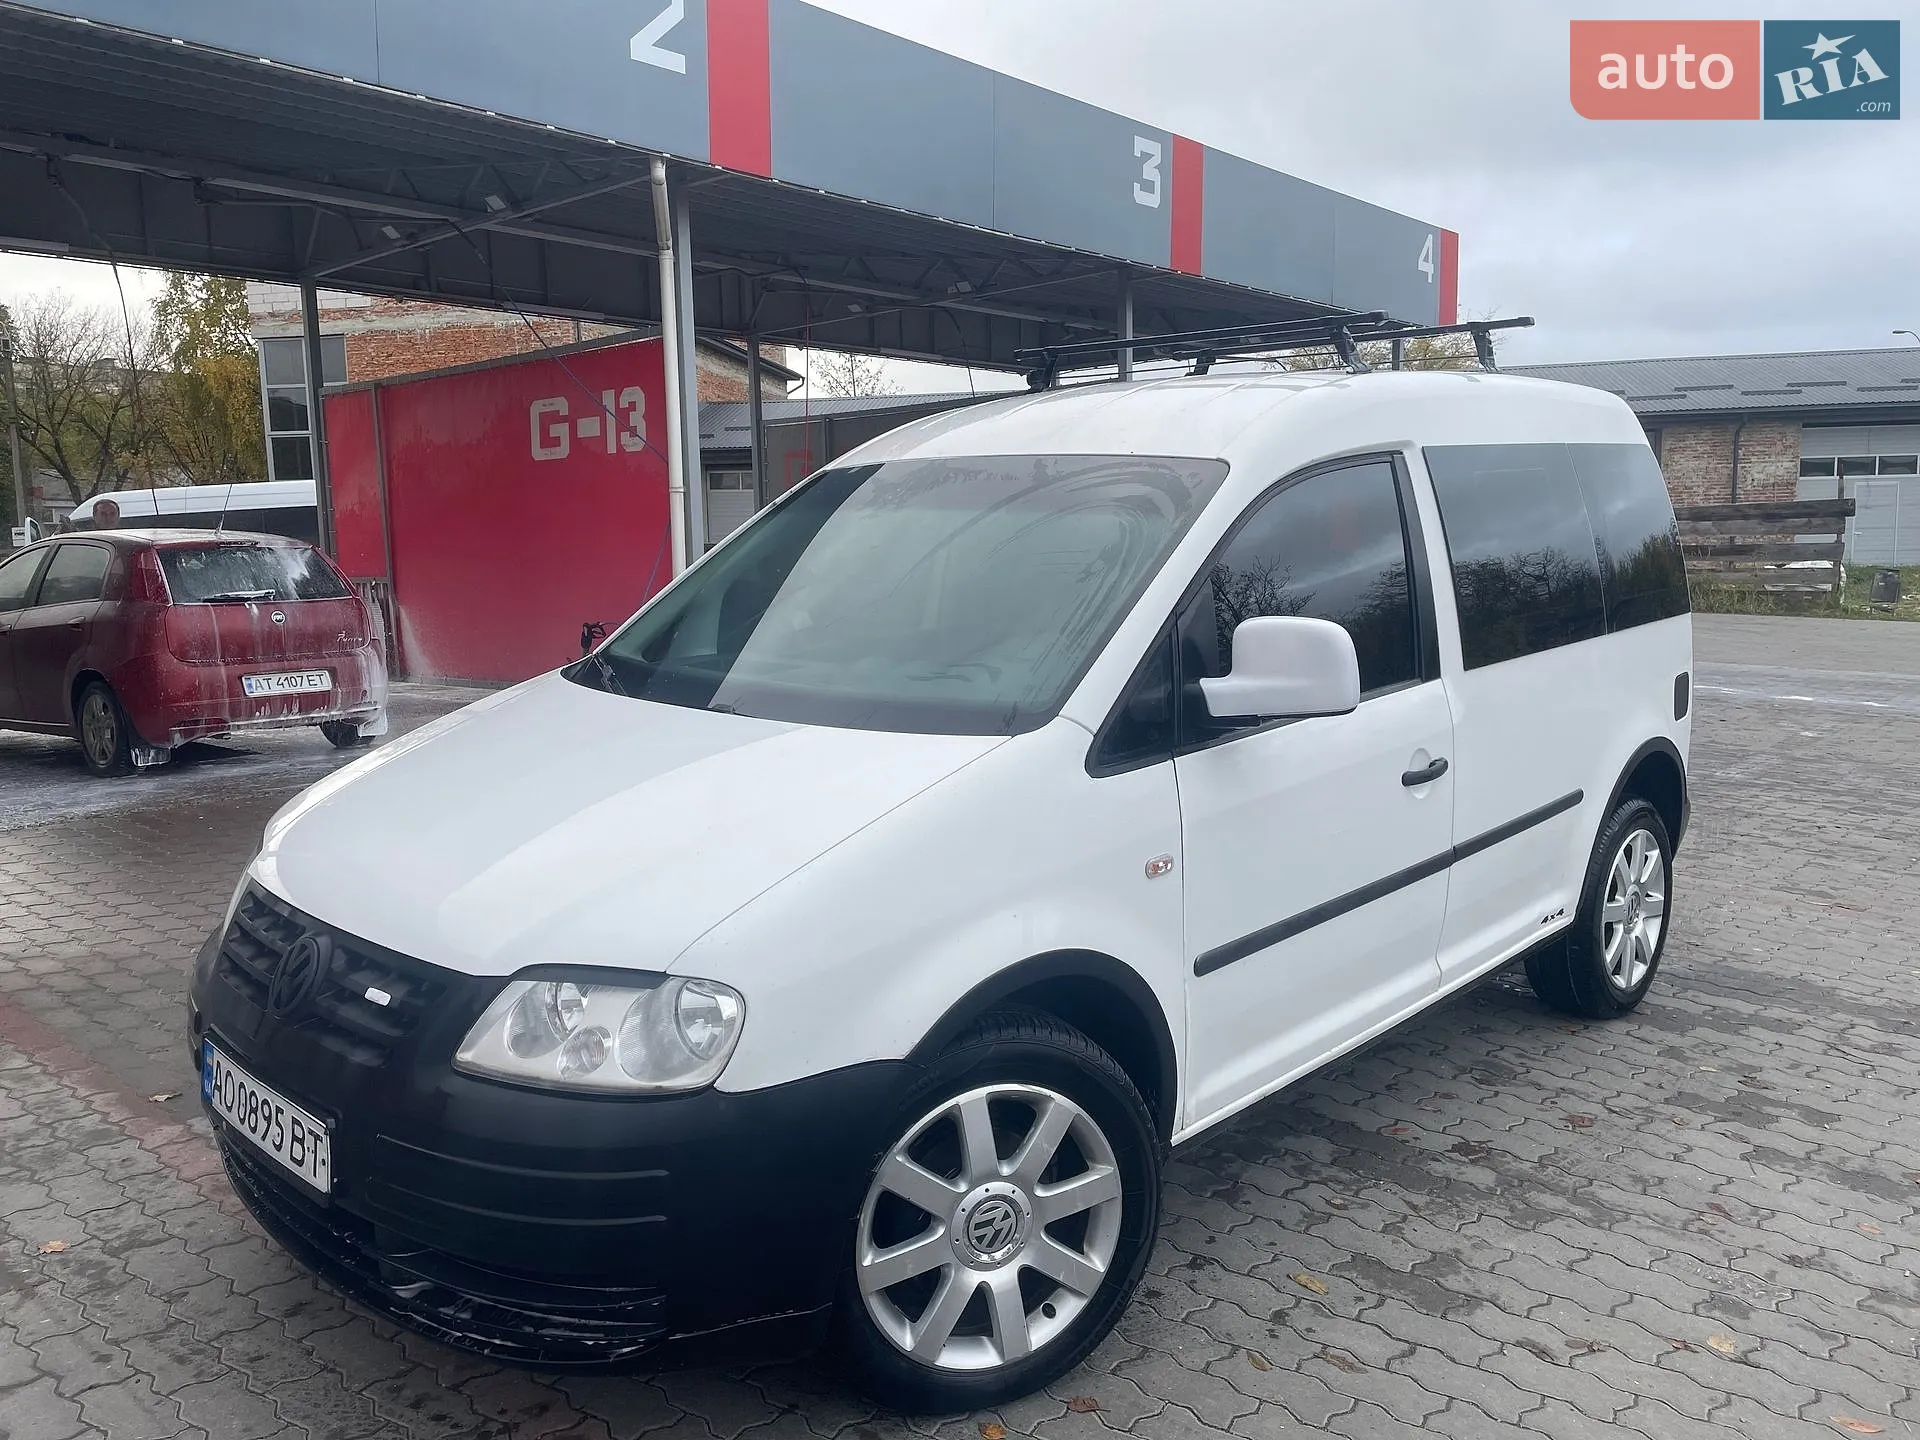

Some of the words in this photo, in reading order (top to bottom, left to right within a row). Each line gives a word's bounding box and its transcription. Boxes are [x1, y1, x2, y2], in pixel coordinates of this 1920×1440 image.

[1133, 135, 1162, 209] 3
[1417, 233, 1435, 284] 4
[529, 385, 647, 462] G-13
